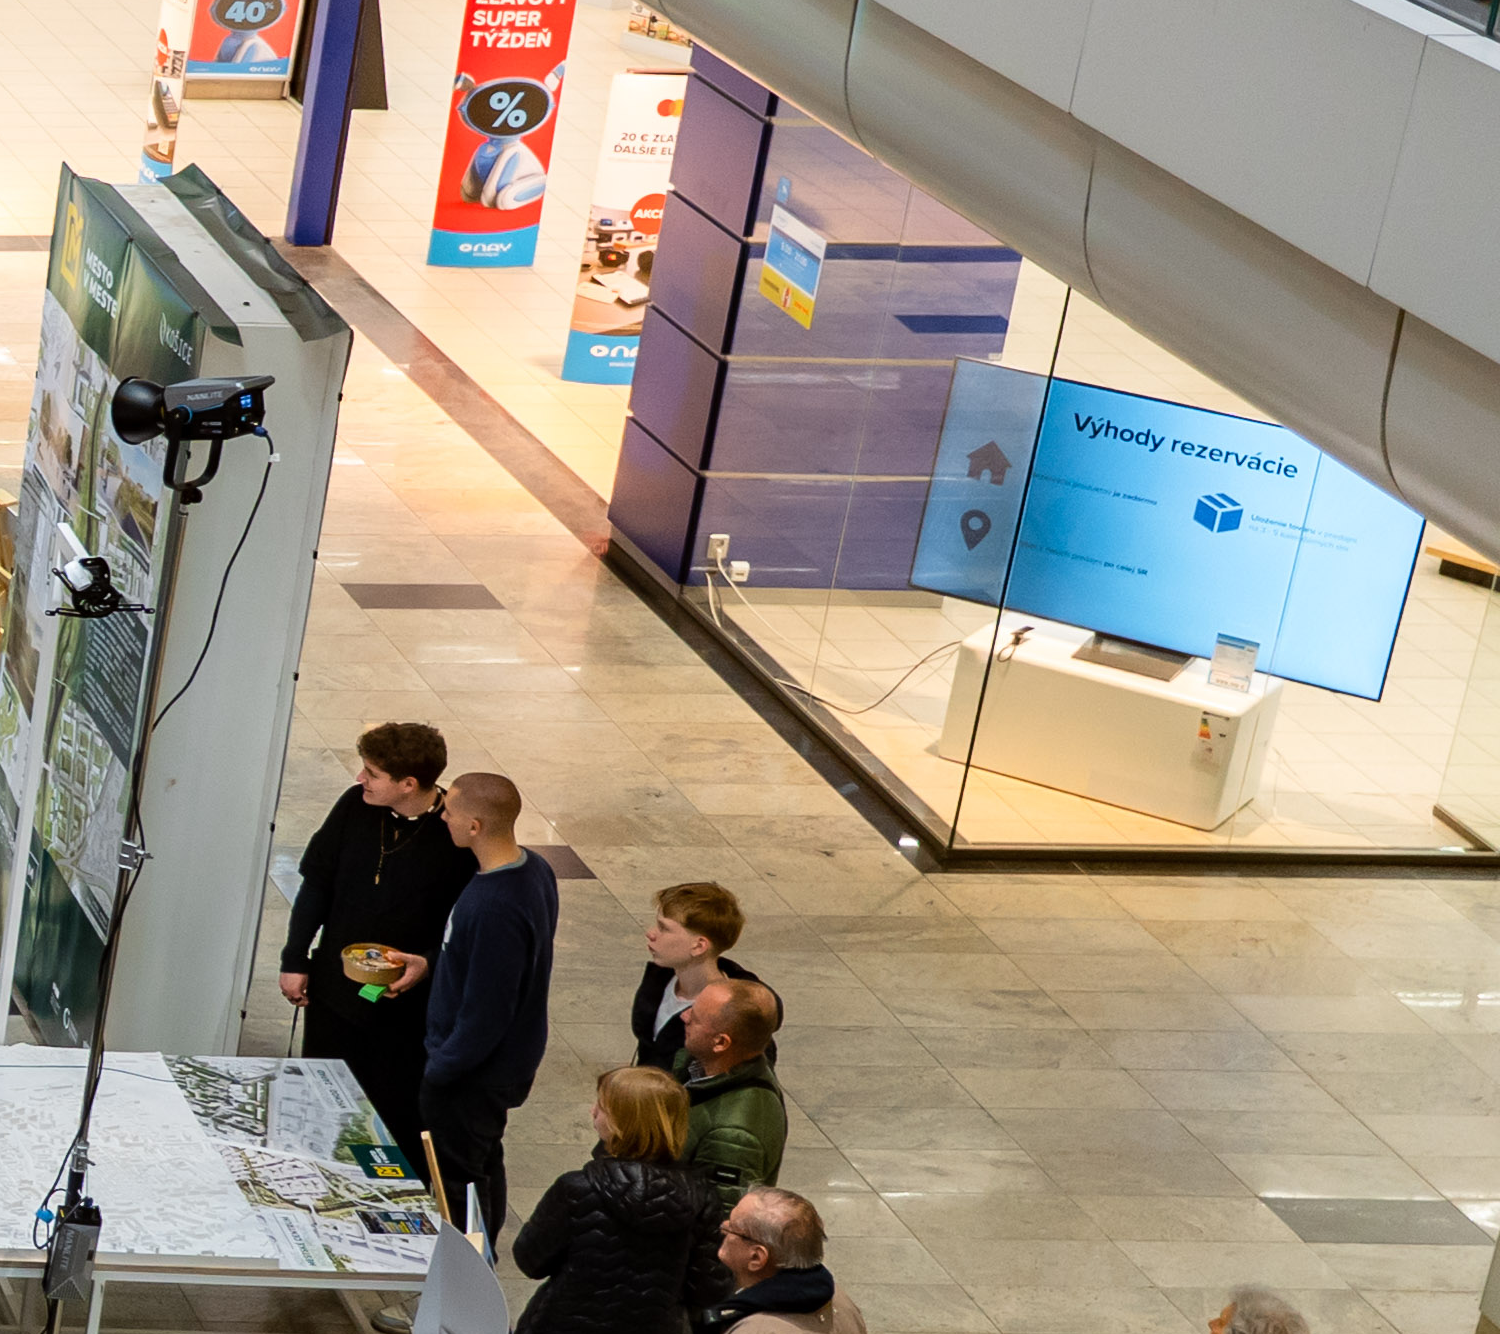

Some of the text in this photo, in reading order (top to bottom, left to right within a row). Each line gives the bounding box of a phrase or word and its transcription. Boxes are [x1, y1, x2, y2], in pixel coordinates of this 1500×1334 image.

[472, 11, 542, 27] SUPER
[470, 28, 552, 48] TÝŽDEŇ
[85, 249, 114, 290] MESTO
[1073, 413, 1298, 479] Výhody rezervácie
